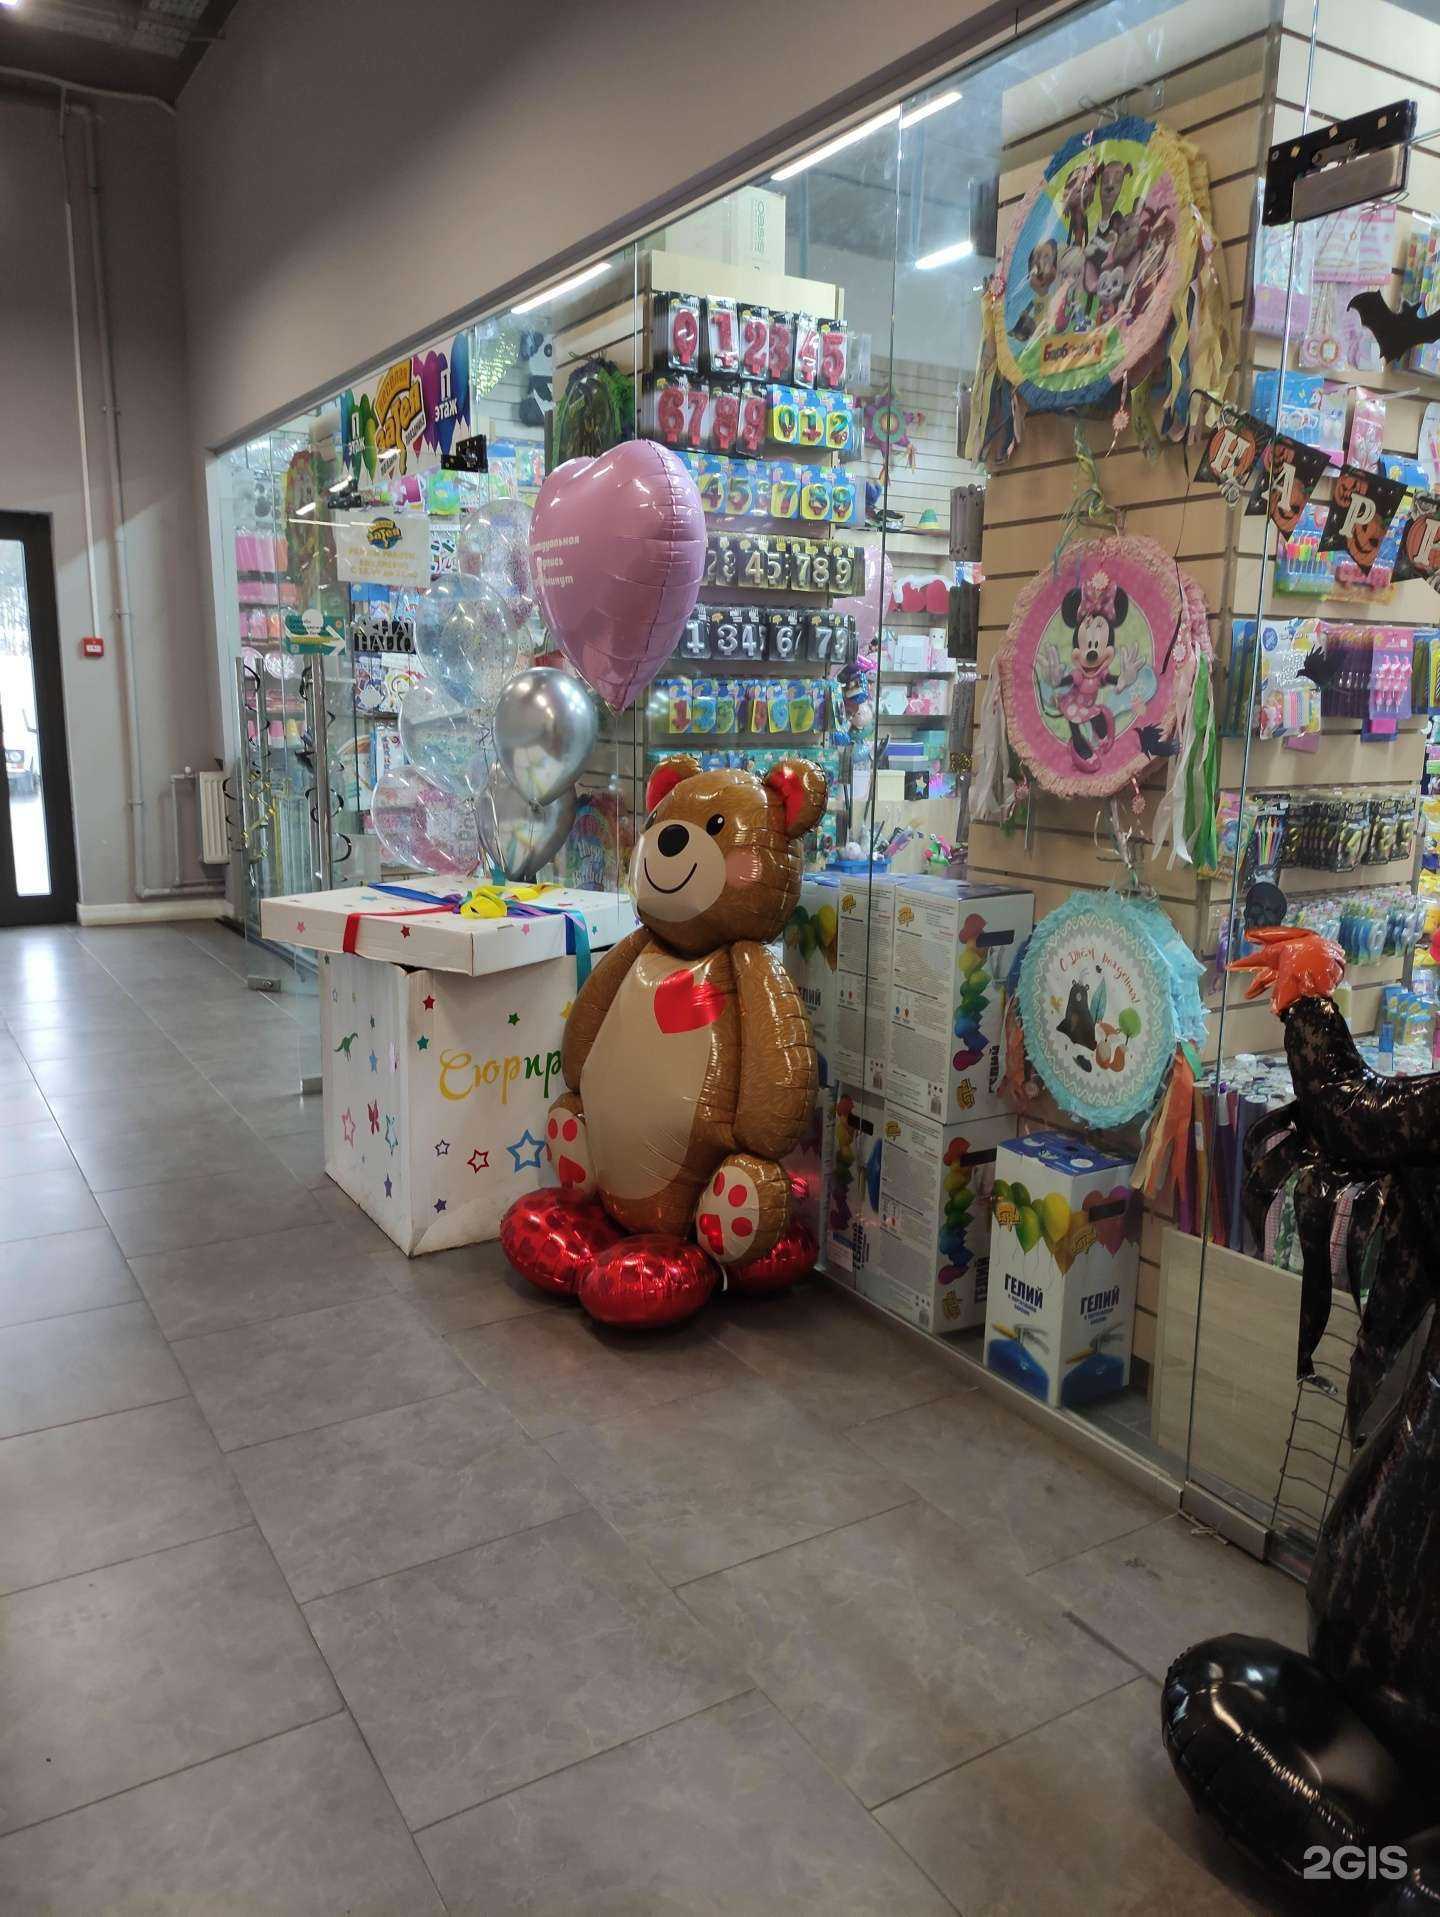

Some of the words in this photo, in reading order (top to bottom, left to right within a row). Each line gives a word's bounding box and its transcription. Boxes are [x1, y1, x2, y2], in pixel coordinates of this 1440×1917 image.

[711, 313, 734, 367] 1
[744, 321, 767, 374] 2
[769, 324, 790, 379] 3
[822, 332, 845, 386] 5
[434, 398, 457, 422] этаж
[658, 387, 685, 442] 6
[688, 392, 708, 445] 7
[713, 397, 738, 449] 8
[778, 480, 799, 514] 7
[745, 550, 764, 583] 4
[767, 553, 781, 582] 5
[795, 553, 811, 587] 7
[813, 557, 829, 588] 8
[836, 559, 850, 589] 9
[686, 621, 704, 653] 1
[717, 624, 738, 656] 3
[742, 624, 757, 656] 4
[776, 626, 793, 657] 6
[815, 628, 832, 658] 7
[439, 1049, 562, 1104] Сюрпр
[1004, 1273, 1044, 1309] ГЕЛИЙ
[1080, 1285, 1120, 1315] ГЕЛИЙ
